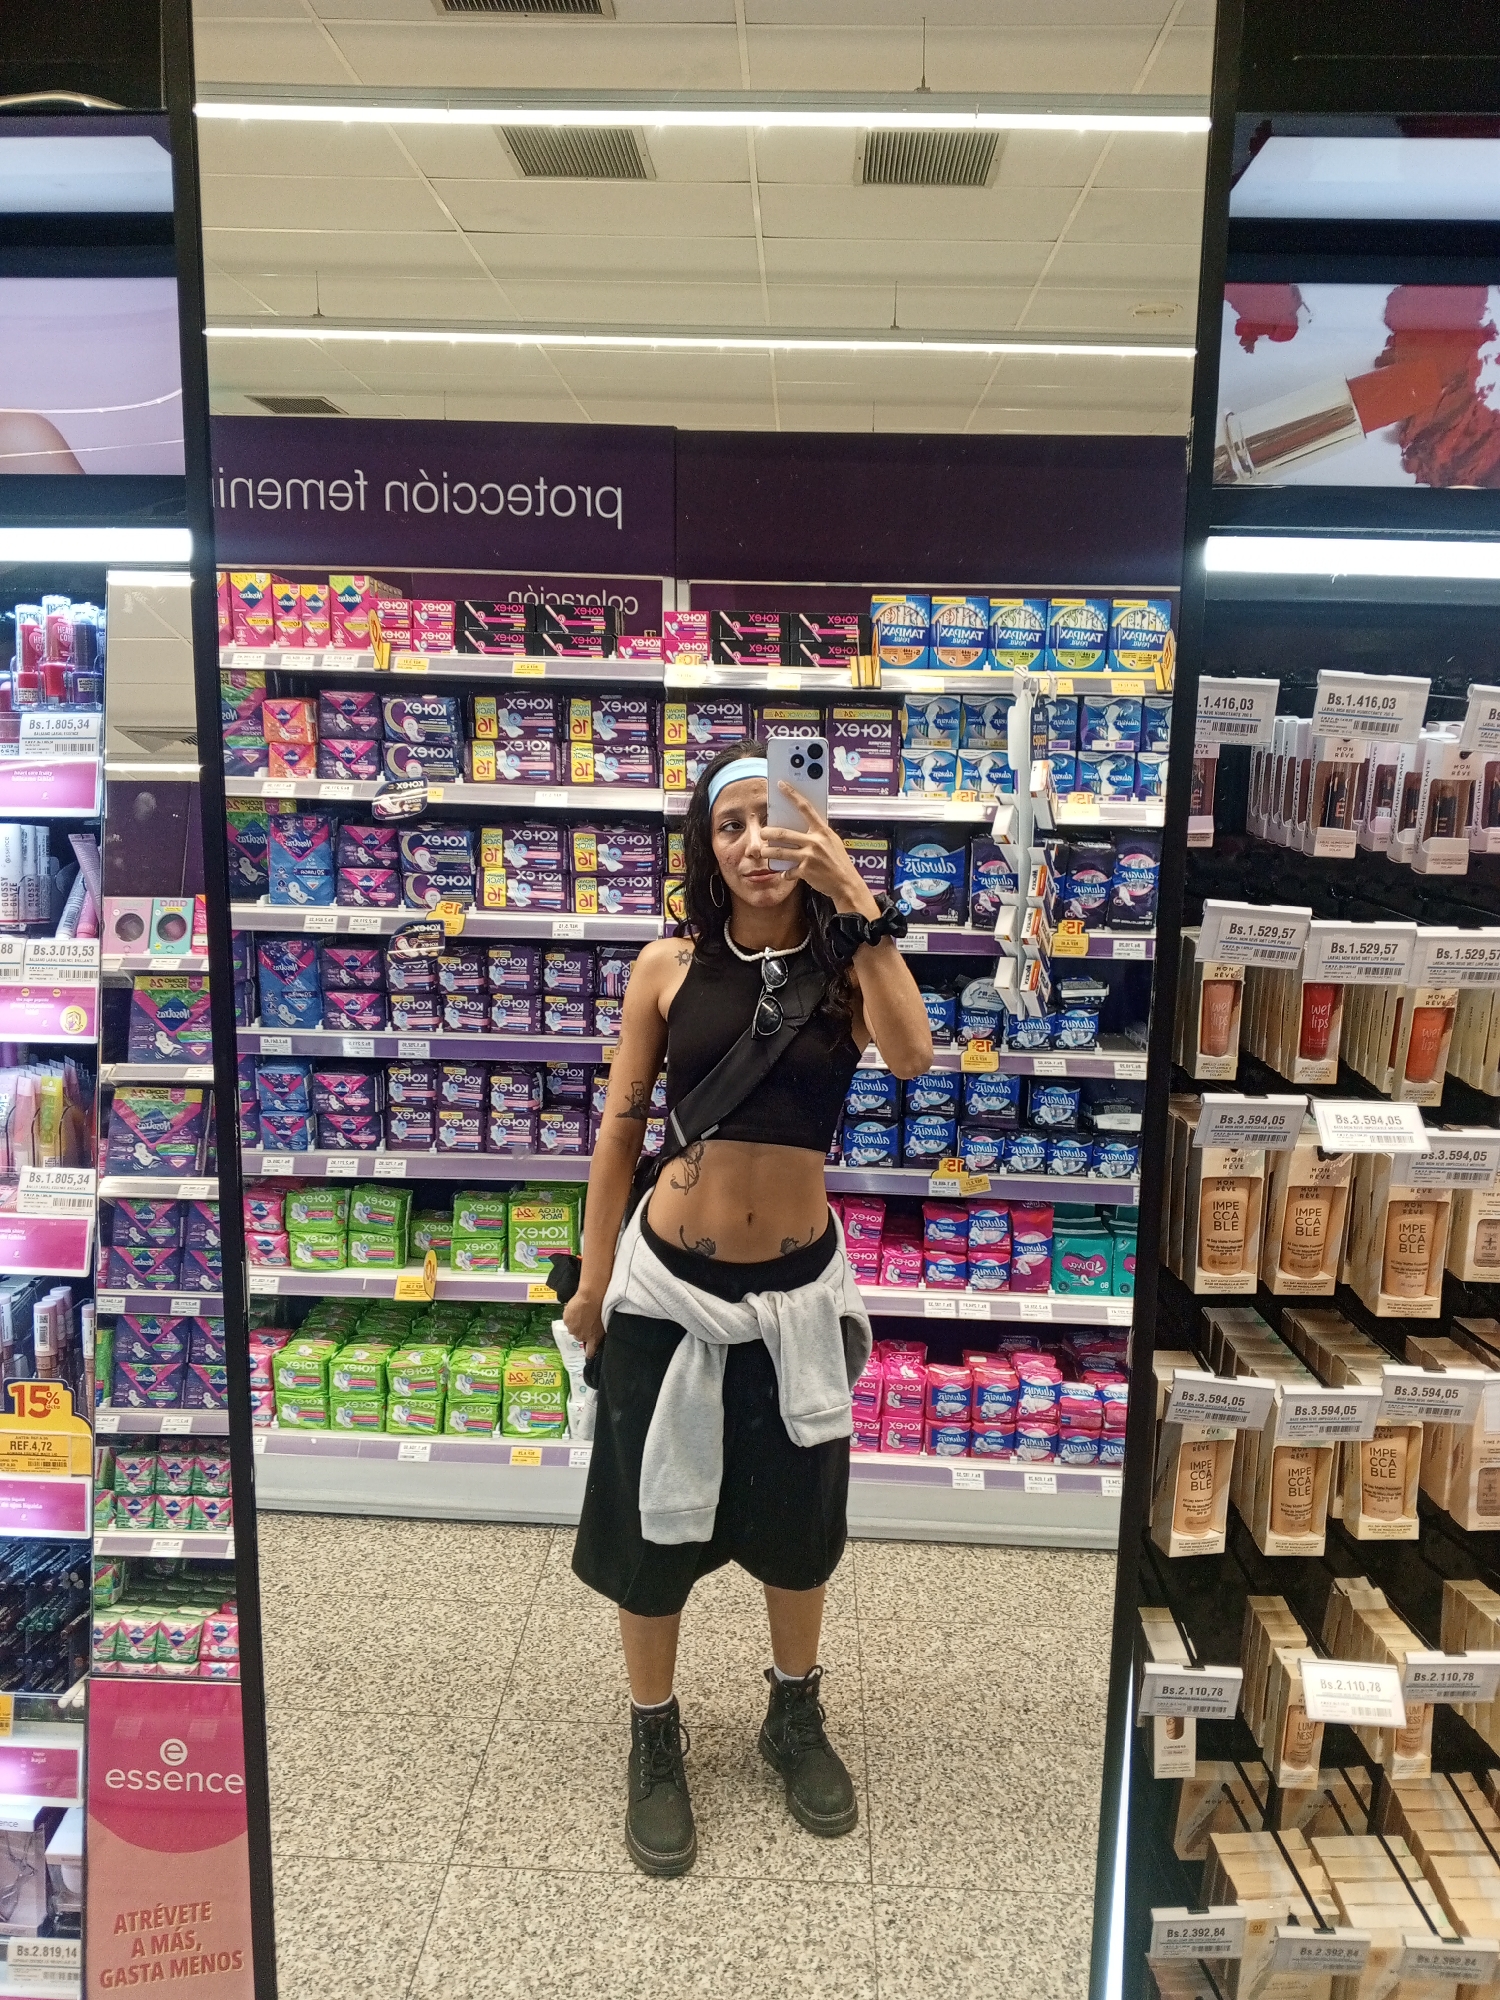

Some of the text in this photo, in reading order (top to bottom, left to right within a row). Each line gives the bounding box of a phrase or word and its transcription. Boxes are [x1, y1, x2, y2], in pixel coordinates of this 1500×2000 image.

[1198, 696, 1255, 711] .1.416,03
[1327, 692, 1397, 711] Bs.1.416,03
[28, 718, 91, 731] Bs.1.805,34
[1229, 923, 1297, 939] Bs.1.529,57
[33, 944, 95, 958] Bs.3.013,53
[1330, 942, 1398, 956] Bs.1.529,57
[1212, 1001, 1231, 1013] wet
[1311, 1002, 1331, 1016] wet
[1211, 1014, 1228, 1031] lips
[1311, 1016, 1329, 1033] lips
[1219, 1114, 1286, 1127] Bs.3.594,05
[1335, 1113, 1402, 1126] Bs.3.594,05
[28, 1171, 91, 1186] Bs.1.805,34
[1212, 1201, 1240, 1211] IMPE
[1295, 1207, 1322, 1217] IMPE
[1212, 1211, 1240, 1221] CCA
[1295, 1217, 1321, 1226] CCA
[1213, 1221, 1239, 1231] BLE
[1295, 1226, 1321, 1237] BLE
[1399, 1224, 1427, 1234] IMPE
[1398, 1234, 1426, 1244] CCA
[1399, 1243, 1425, 1254] BLE
[1394, 1385, 1459, 1399] Bs.3.594,05
[1181, 1391, 1246, 1407] Bs.3.594,05
[1294, 1405, 1357, 1417] Bs.3.594,05
[10, 1440, 53, 1453] REF.4,72
[1369, 1447, 1397, 1458] IMPE
[1190, 1459, 1213, 1471] IMPE
[1369, 1457, 1397, 1468] CCA
[1189, 1470, 1213, 1481] CCA
[1288, 1466, 1312, 1477] IMPE
[1370, 1468, 1397, 1479] BLE
[1190, 1480, 1213, 1491] BLE
[1287, 1476, 1312, 1487] CCA
[1288, 1486, 1311, 1497] BLE
[1413, 1672, 1475, 1683] Bs.2.110,78
[1161, 1685, 1224, 1697] Bs.2.110,78
[1320, 1678, 1382, 1693] Bs.2.110,78
[105, 1768, 246, 1795] essence
[113, 1900, 213, 1936] ATRÉVETE
[1167, 1927, 1226, 1939] Bs.2.392,84
[131, 1929, 203, 1960] A MÁS,
[16, 1945, 78, 1959] Bs.2.819,14
[1300, 1947, 1360, 1959] Bs.2.392,84
[100, 1949, 246, 1990] GASTA MENOS
